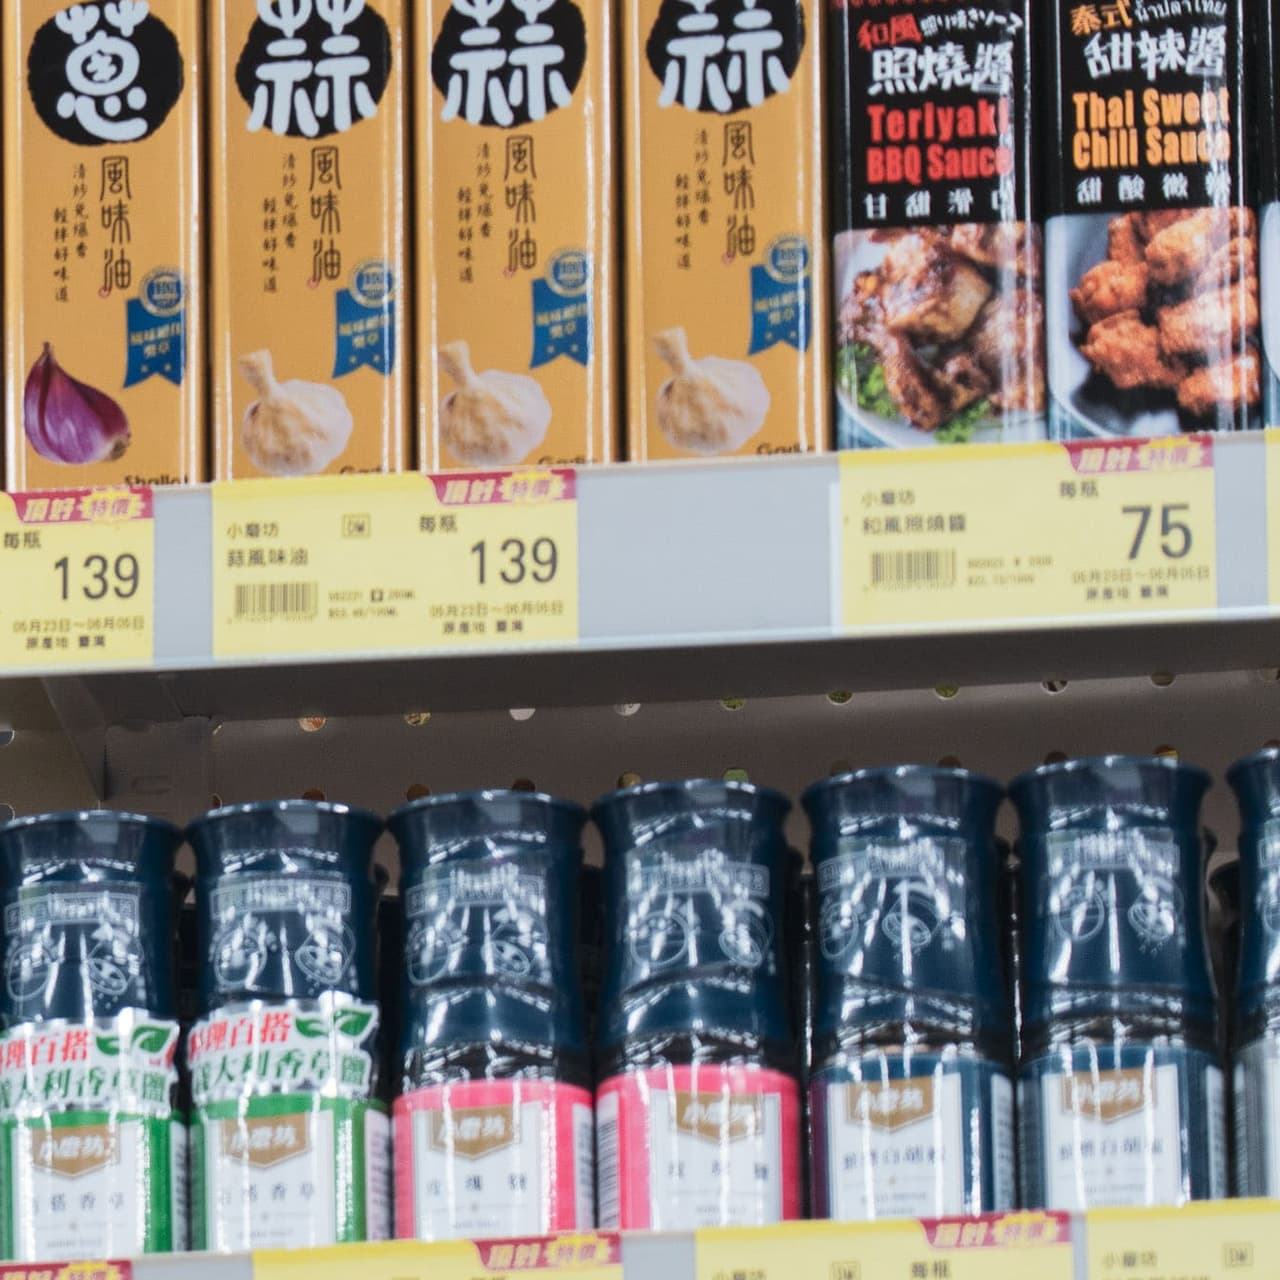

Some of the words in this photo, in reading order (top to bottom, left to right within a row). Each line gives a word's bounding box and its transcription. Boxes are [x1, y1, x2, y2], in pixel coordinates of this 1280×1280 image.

[858, 12, 922, 51] 和風
[1071, 0, 1133, 36] 泰式
[244, 0, 378, 137] 蒜
[440, 0, 573, 128] 蒜
[867, 41, 1014, 96] 照燒醬
[1083, 25, 1227, 81] 甜辣醬
[867, 98, 1010, 144] Teriyaki
[1072, 89, 1134, 129] Thai
[1142, 87, 1230, 127] Sweet
[867, 146, 923, 186] BBQ
[927, 145, 1012, 179] Sauce
[1073, 128, 1138, 171] Chili
[1145, 126, 1231, 166] Sauce
[309, 146, 342, 283] 風味油
[504, 134, 537, 271] 風味油
[722, 121, 756, 258] 風味油
[100, 156, 132, 291] 風味油
[1122, 503, 1194, 561] 75
[54, 553, 140, 601] 139
[471, 538, 558, 585] 139
